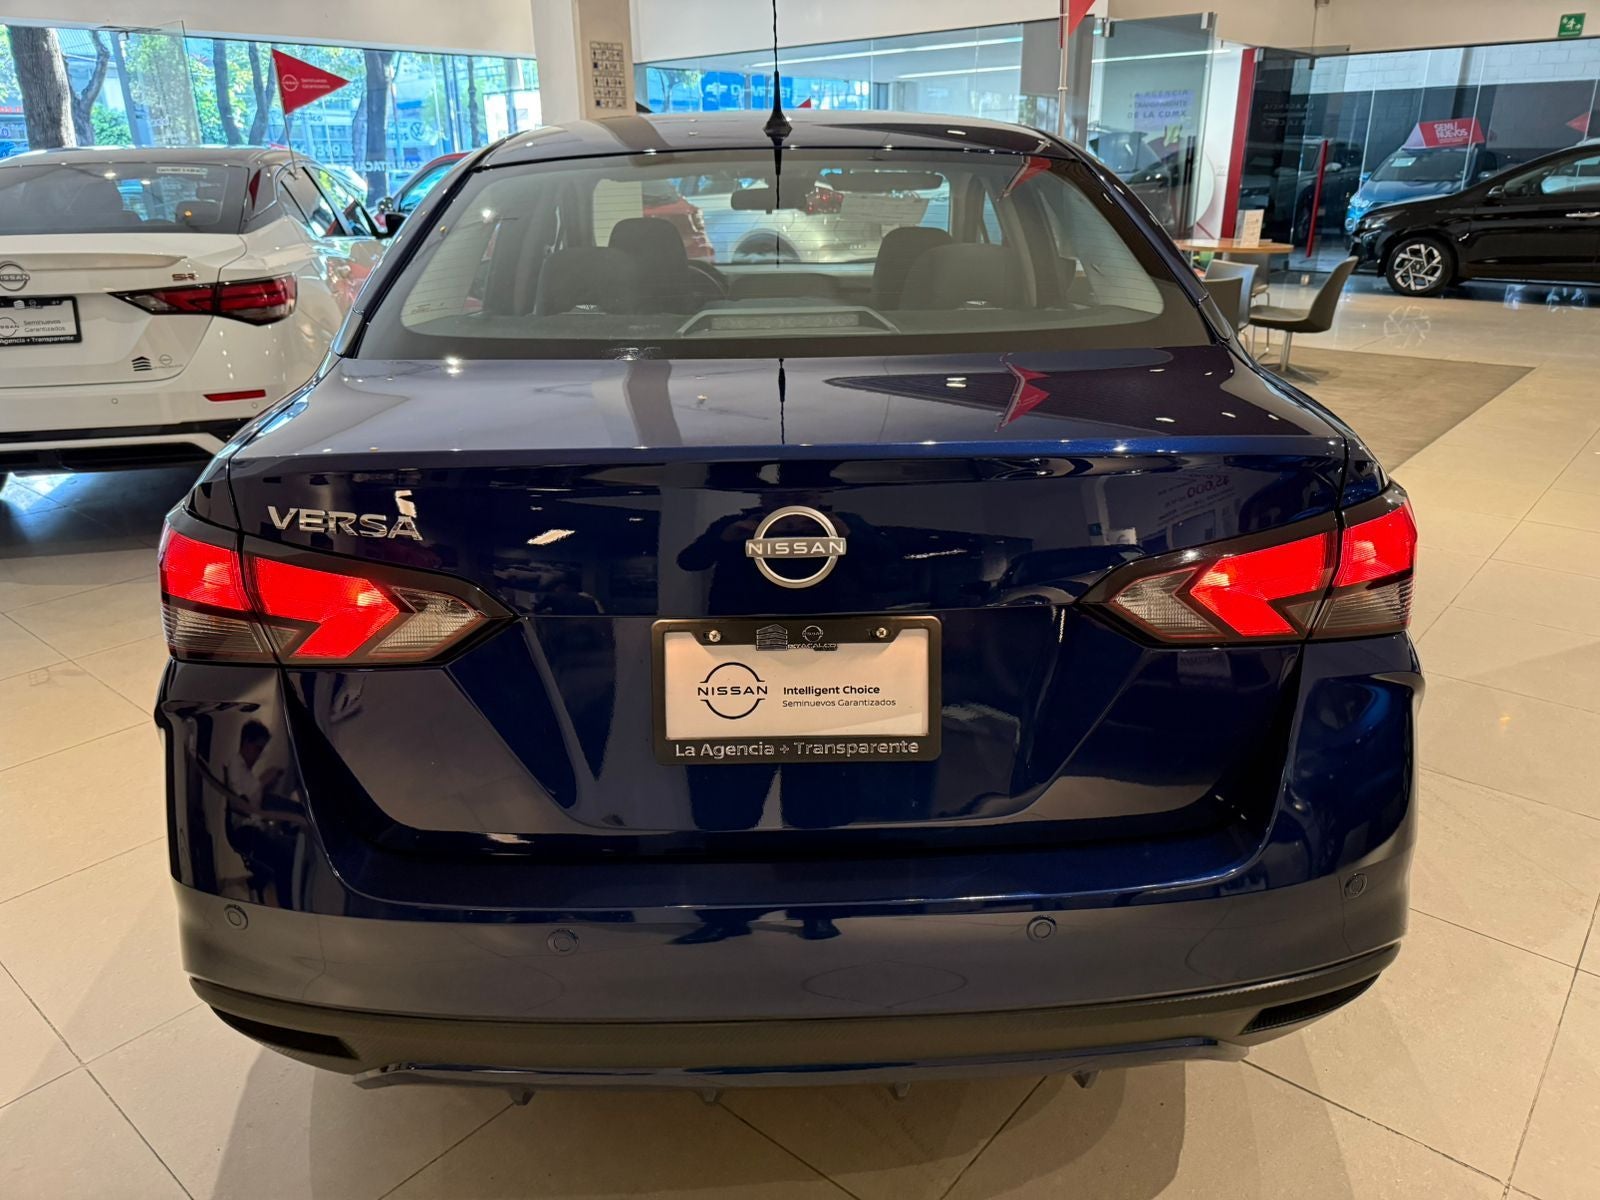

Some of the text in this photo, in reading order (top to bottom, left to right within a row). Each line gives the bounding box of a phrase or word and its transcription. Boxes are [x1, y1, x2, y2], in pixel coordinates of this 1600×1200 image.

[1127, 111, 1139, 119] DE
[0, 274, 30, 282] ISSAN
[172, 273, 196, 281] SR
[267, 505, 423, 541] VERSA
[748, 541, 844, 555] NISSAN
[697, 685, 768, 696] NISSAN
[783, 685, 880, 697] Intelligent Choice
[782, 698, 897, 708] Seminuevos Garantizados
[675, 744, 696, 757] La
[700, 742, 775, 759] Agencia
[794, 740, 919, 757] Transparente
